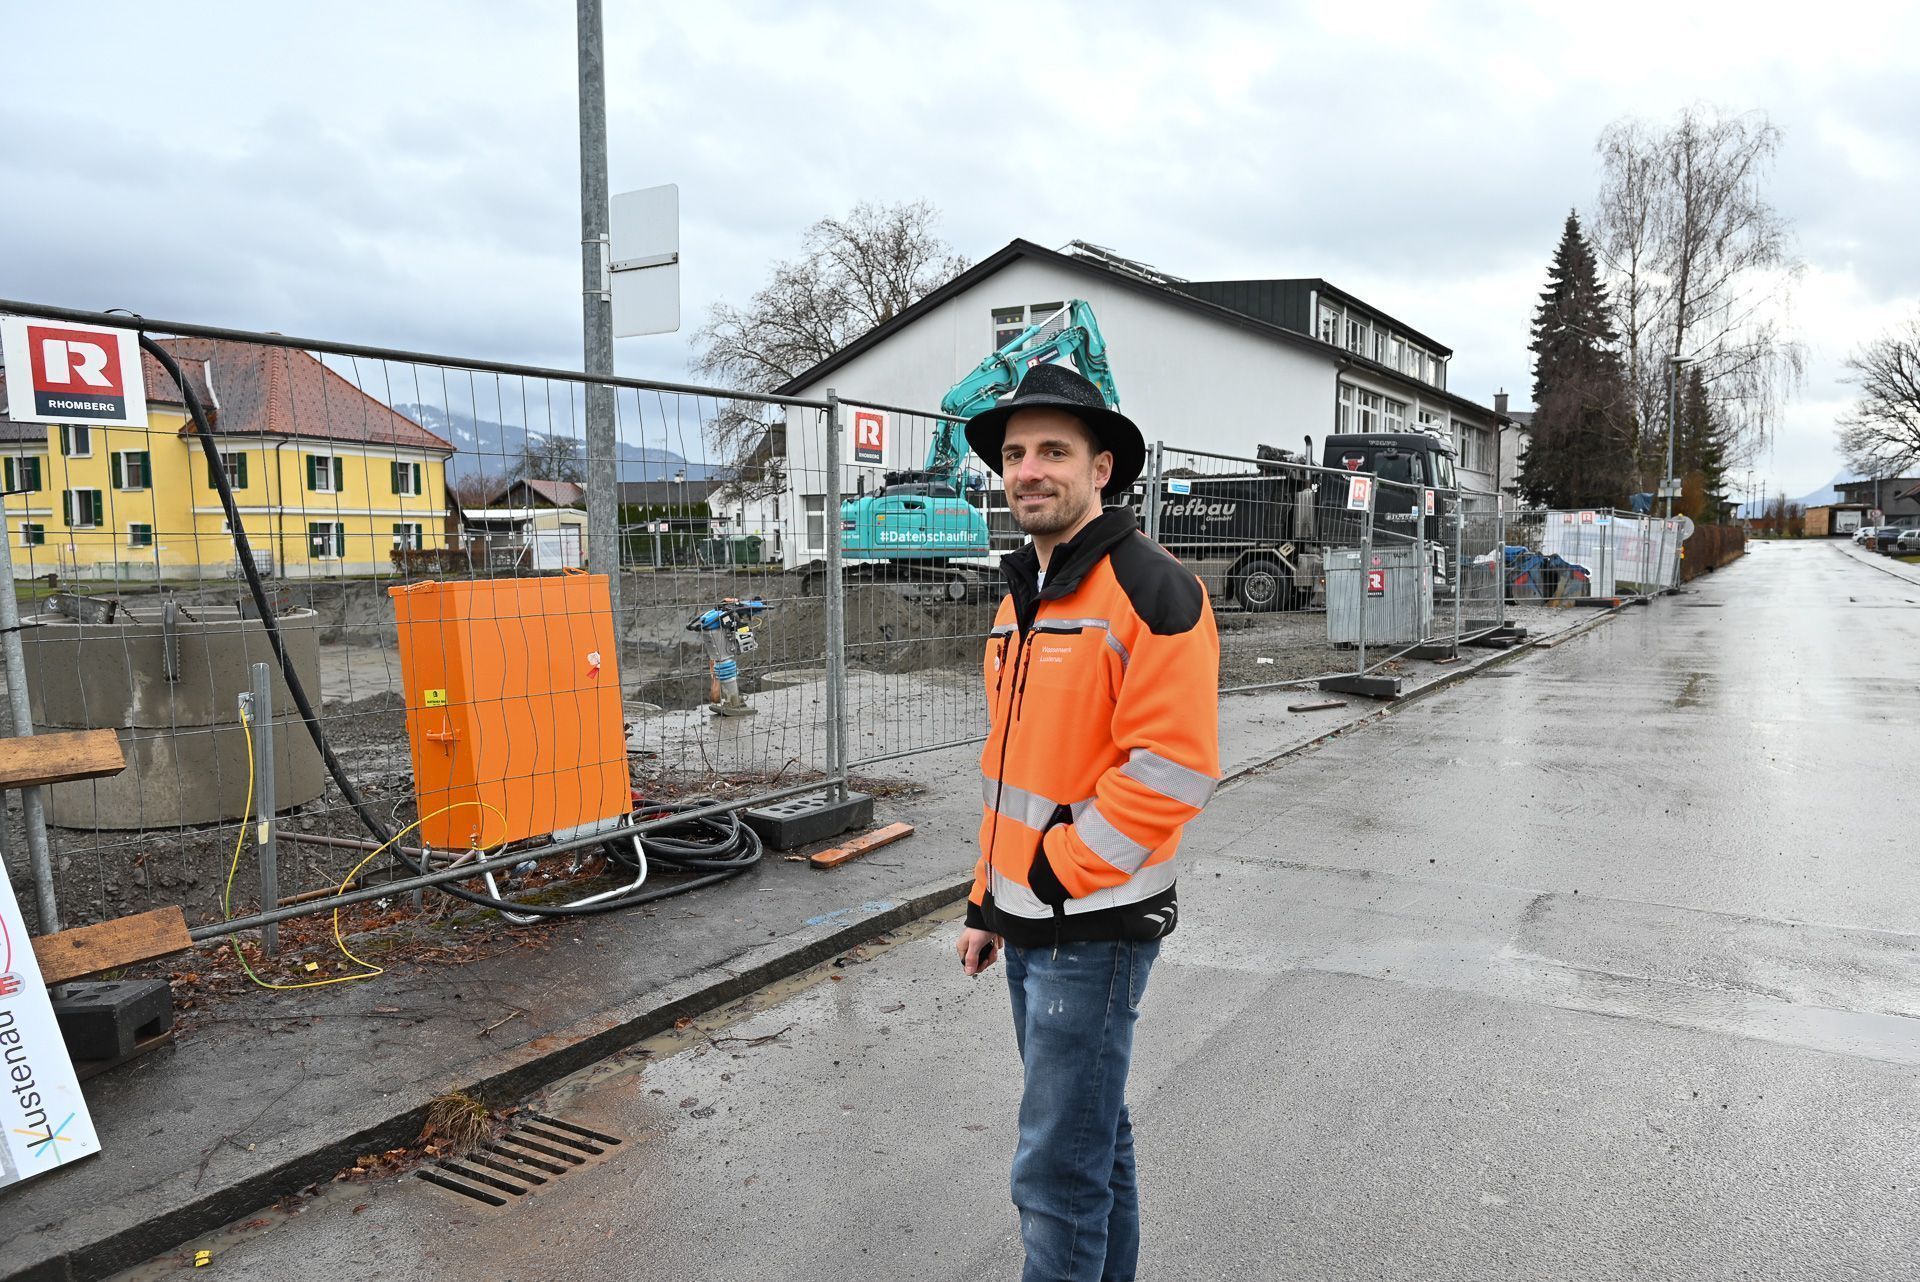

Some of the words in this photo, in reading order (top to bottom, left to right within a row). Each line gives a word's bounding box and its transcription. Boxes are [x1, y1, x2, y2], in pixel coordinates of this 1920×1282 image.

[48, 399, 115, 412] RHOMBERG
[880, 530, 978, 543] #Datenschaufler
[0, 1010, 54, 1148] Lustenau
